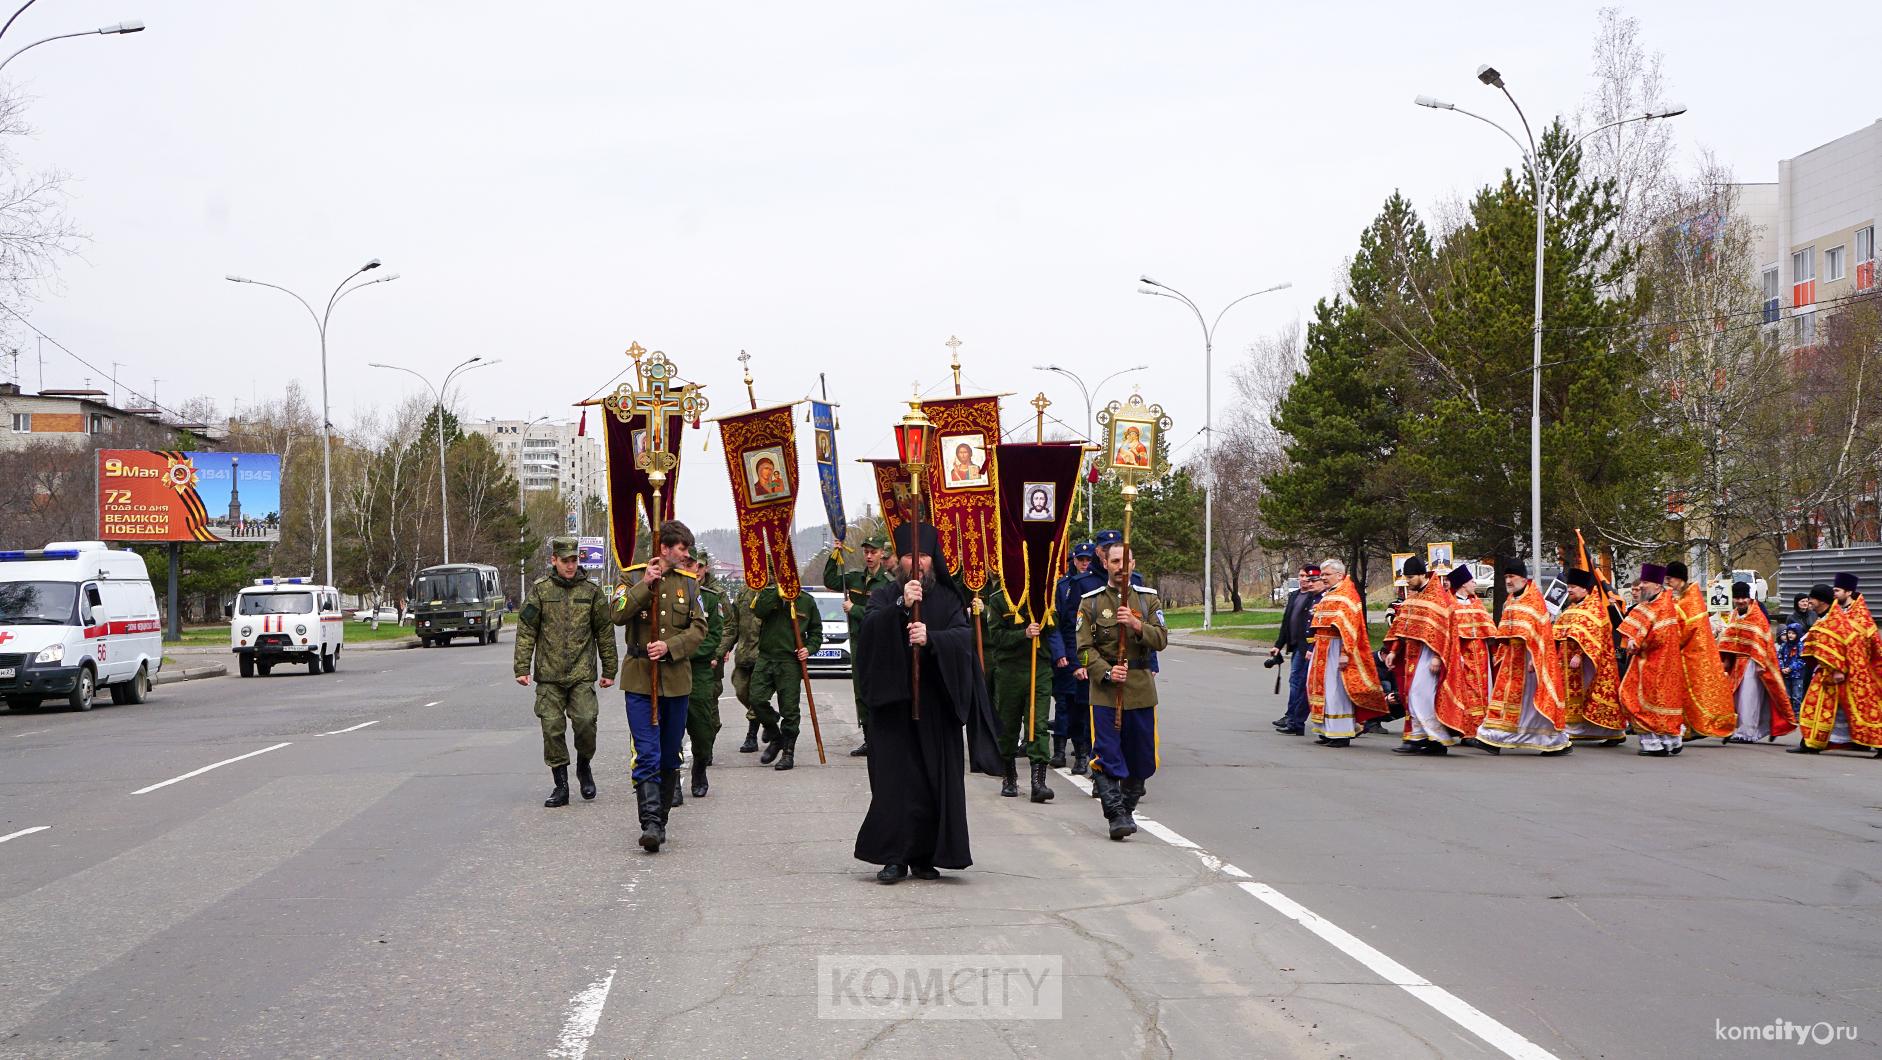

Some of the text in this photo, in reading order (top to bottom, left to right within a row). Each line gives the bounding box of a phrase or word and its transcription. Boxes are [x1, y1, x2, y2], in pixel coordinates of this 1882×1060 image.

[201, 469, 272, 480] 1941 1945
[105, 489, 132, 504] 72
[105, 512, 169, 523] ВЕЛИКОЙ
[105, 524, 169, 534] ПОБЕДЫ
[97, 643, 107, 662] 56
